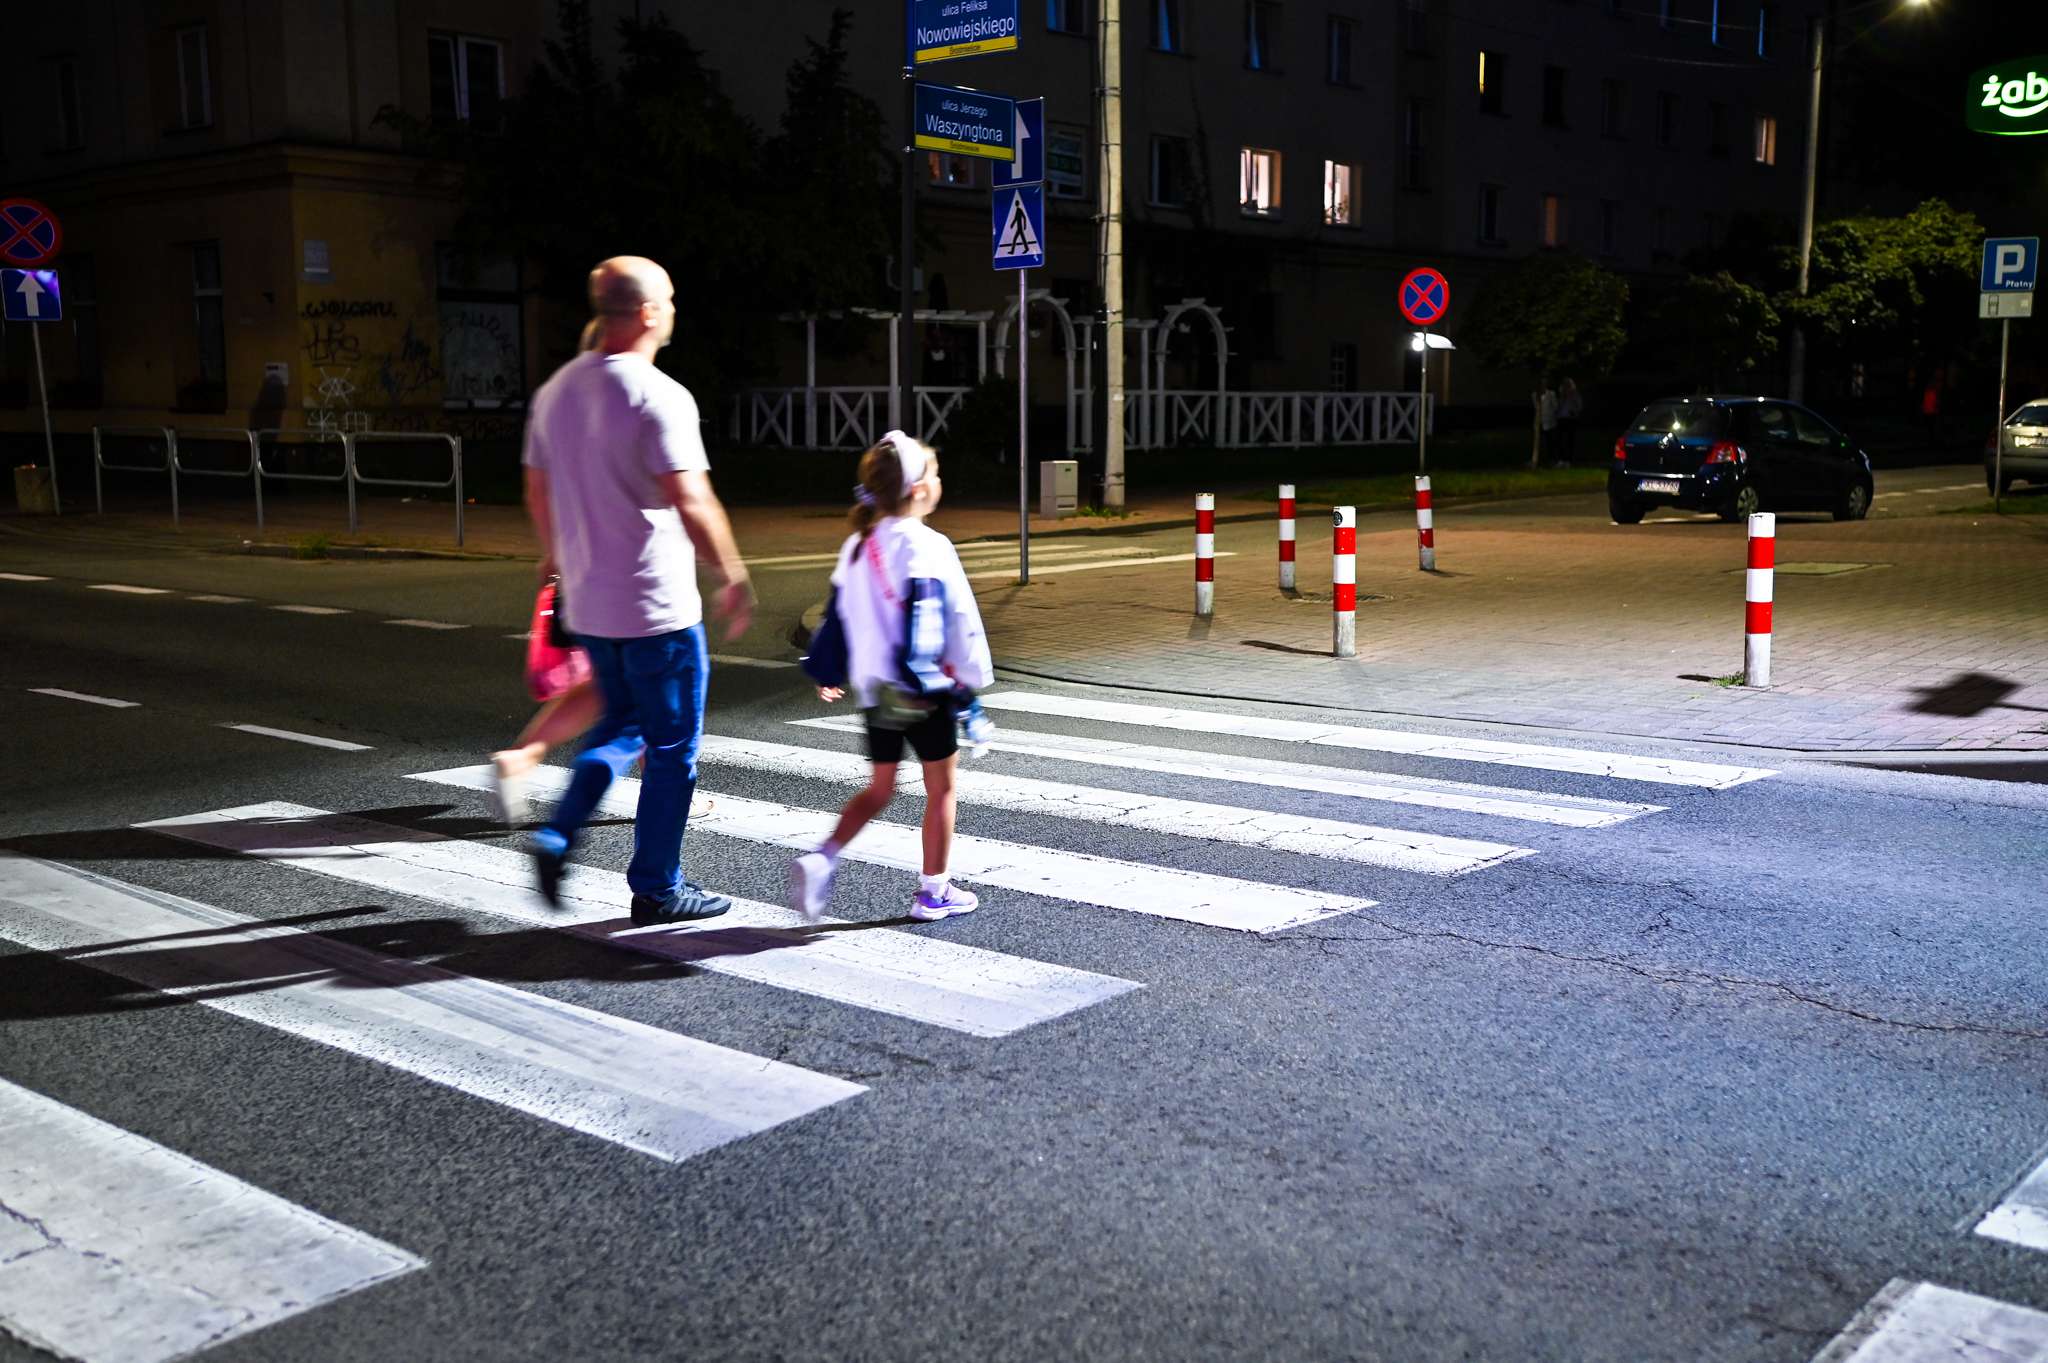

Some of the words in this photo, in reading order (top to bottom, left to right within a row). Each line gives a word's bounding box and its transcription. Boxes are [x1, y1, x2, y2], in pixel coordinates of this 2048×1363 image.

[942, 4, 959, 16] ulica
[961, 0, 988, 13] Feliksa
[917, 16, 1015, 45] Nowowiejskiego
[941, 99, 959, 112] ulica
[960, 102, 988, 119] Jerzego
[925, 113, 1003, 142] Waszyngtona
[1994, 245, 2026, 285] P
